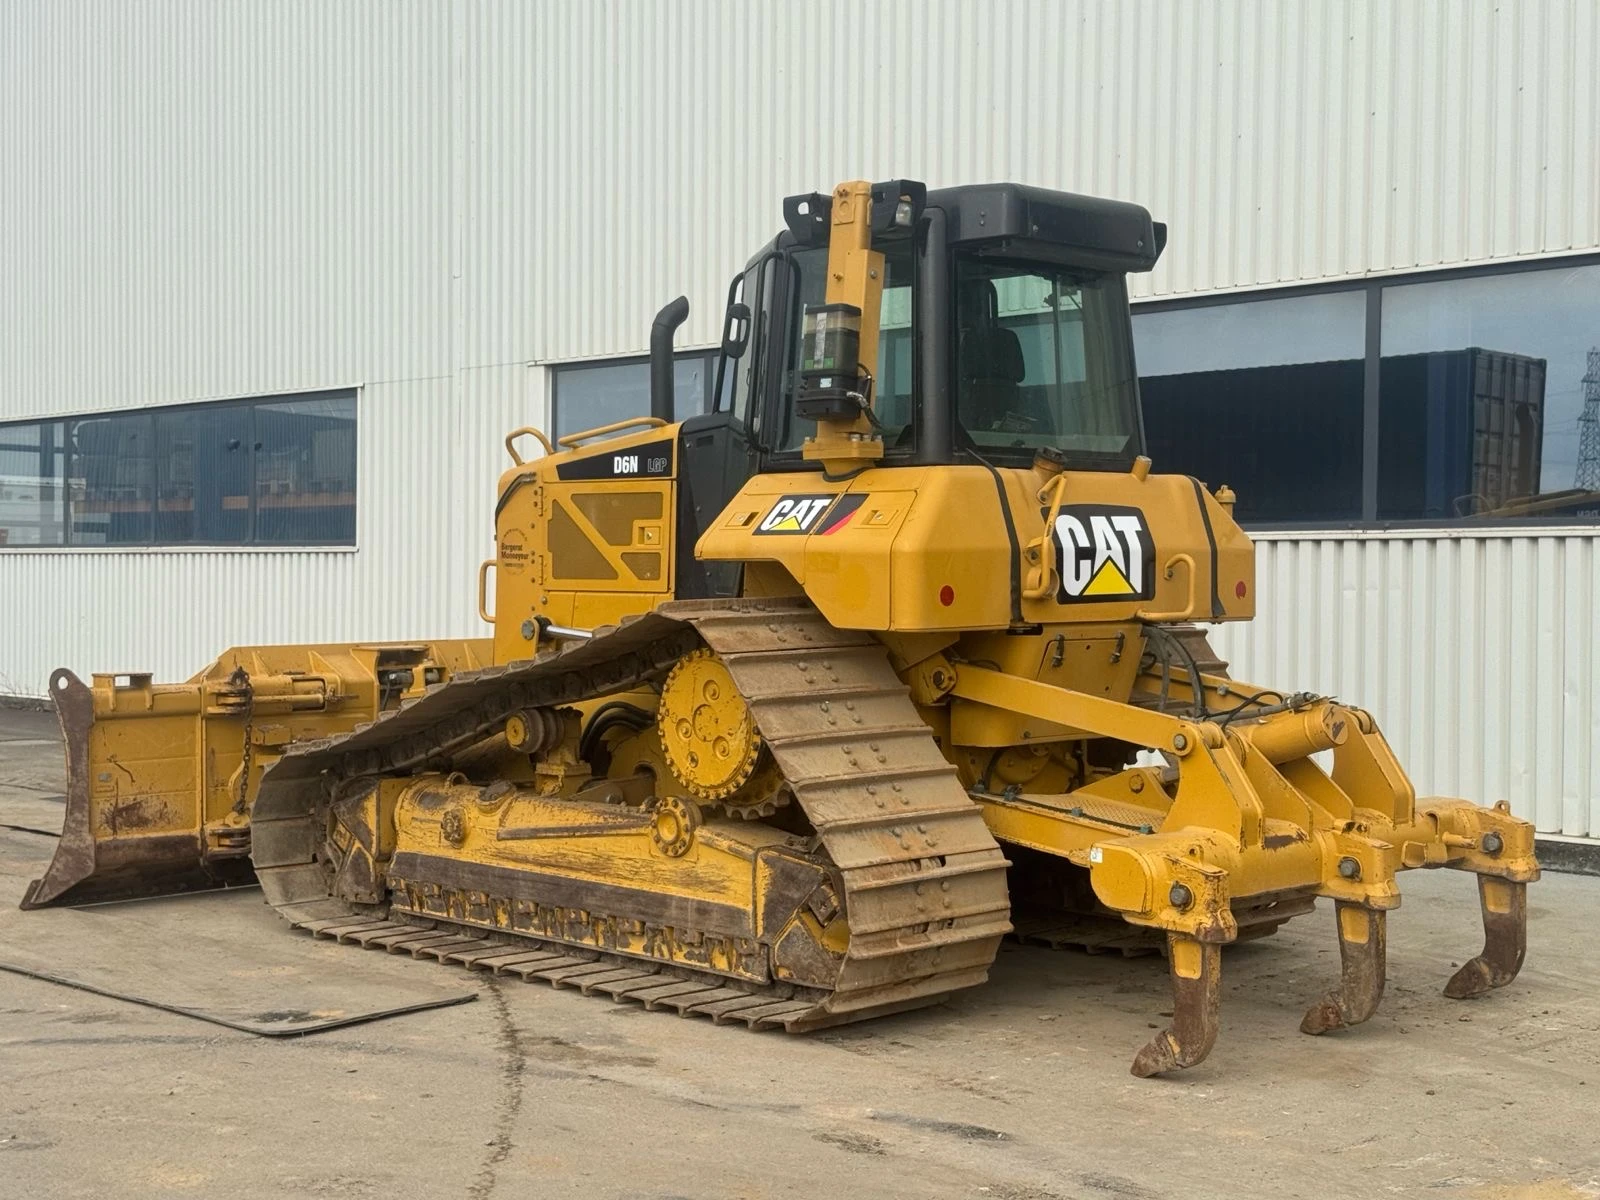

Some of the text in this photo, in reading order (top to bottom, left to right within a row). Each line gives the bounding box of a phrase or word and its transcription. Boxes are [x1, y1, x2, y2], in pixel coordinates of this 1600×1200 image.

[613, 456, 668, 474] D6N LGP
[760, 499, 833, 531] CAT
[1055, 514, 1143, 597] CAT
